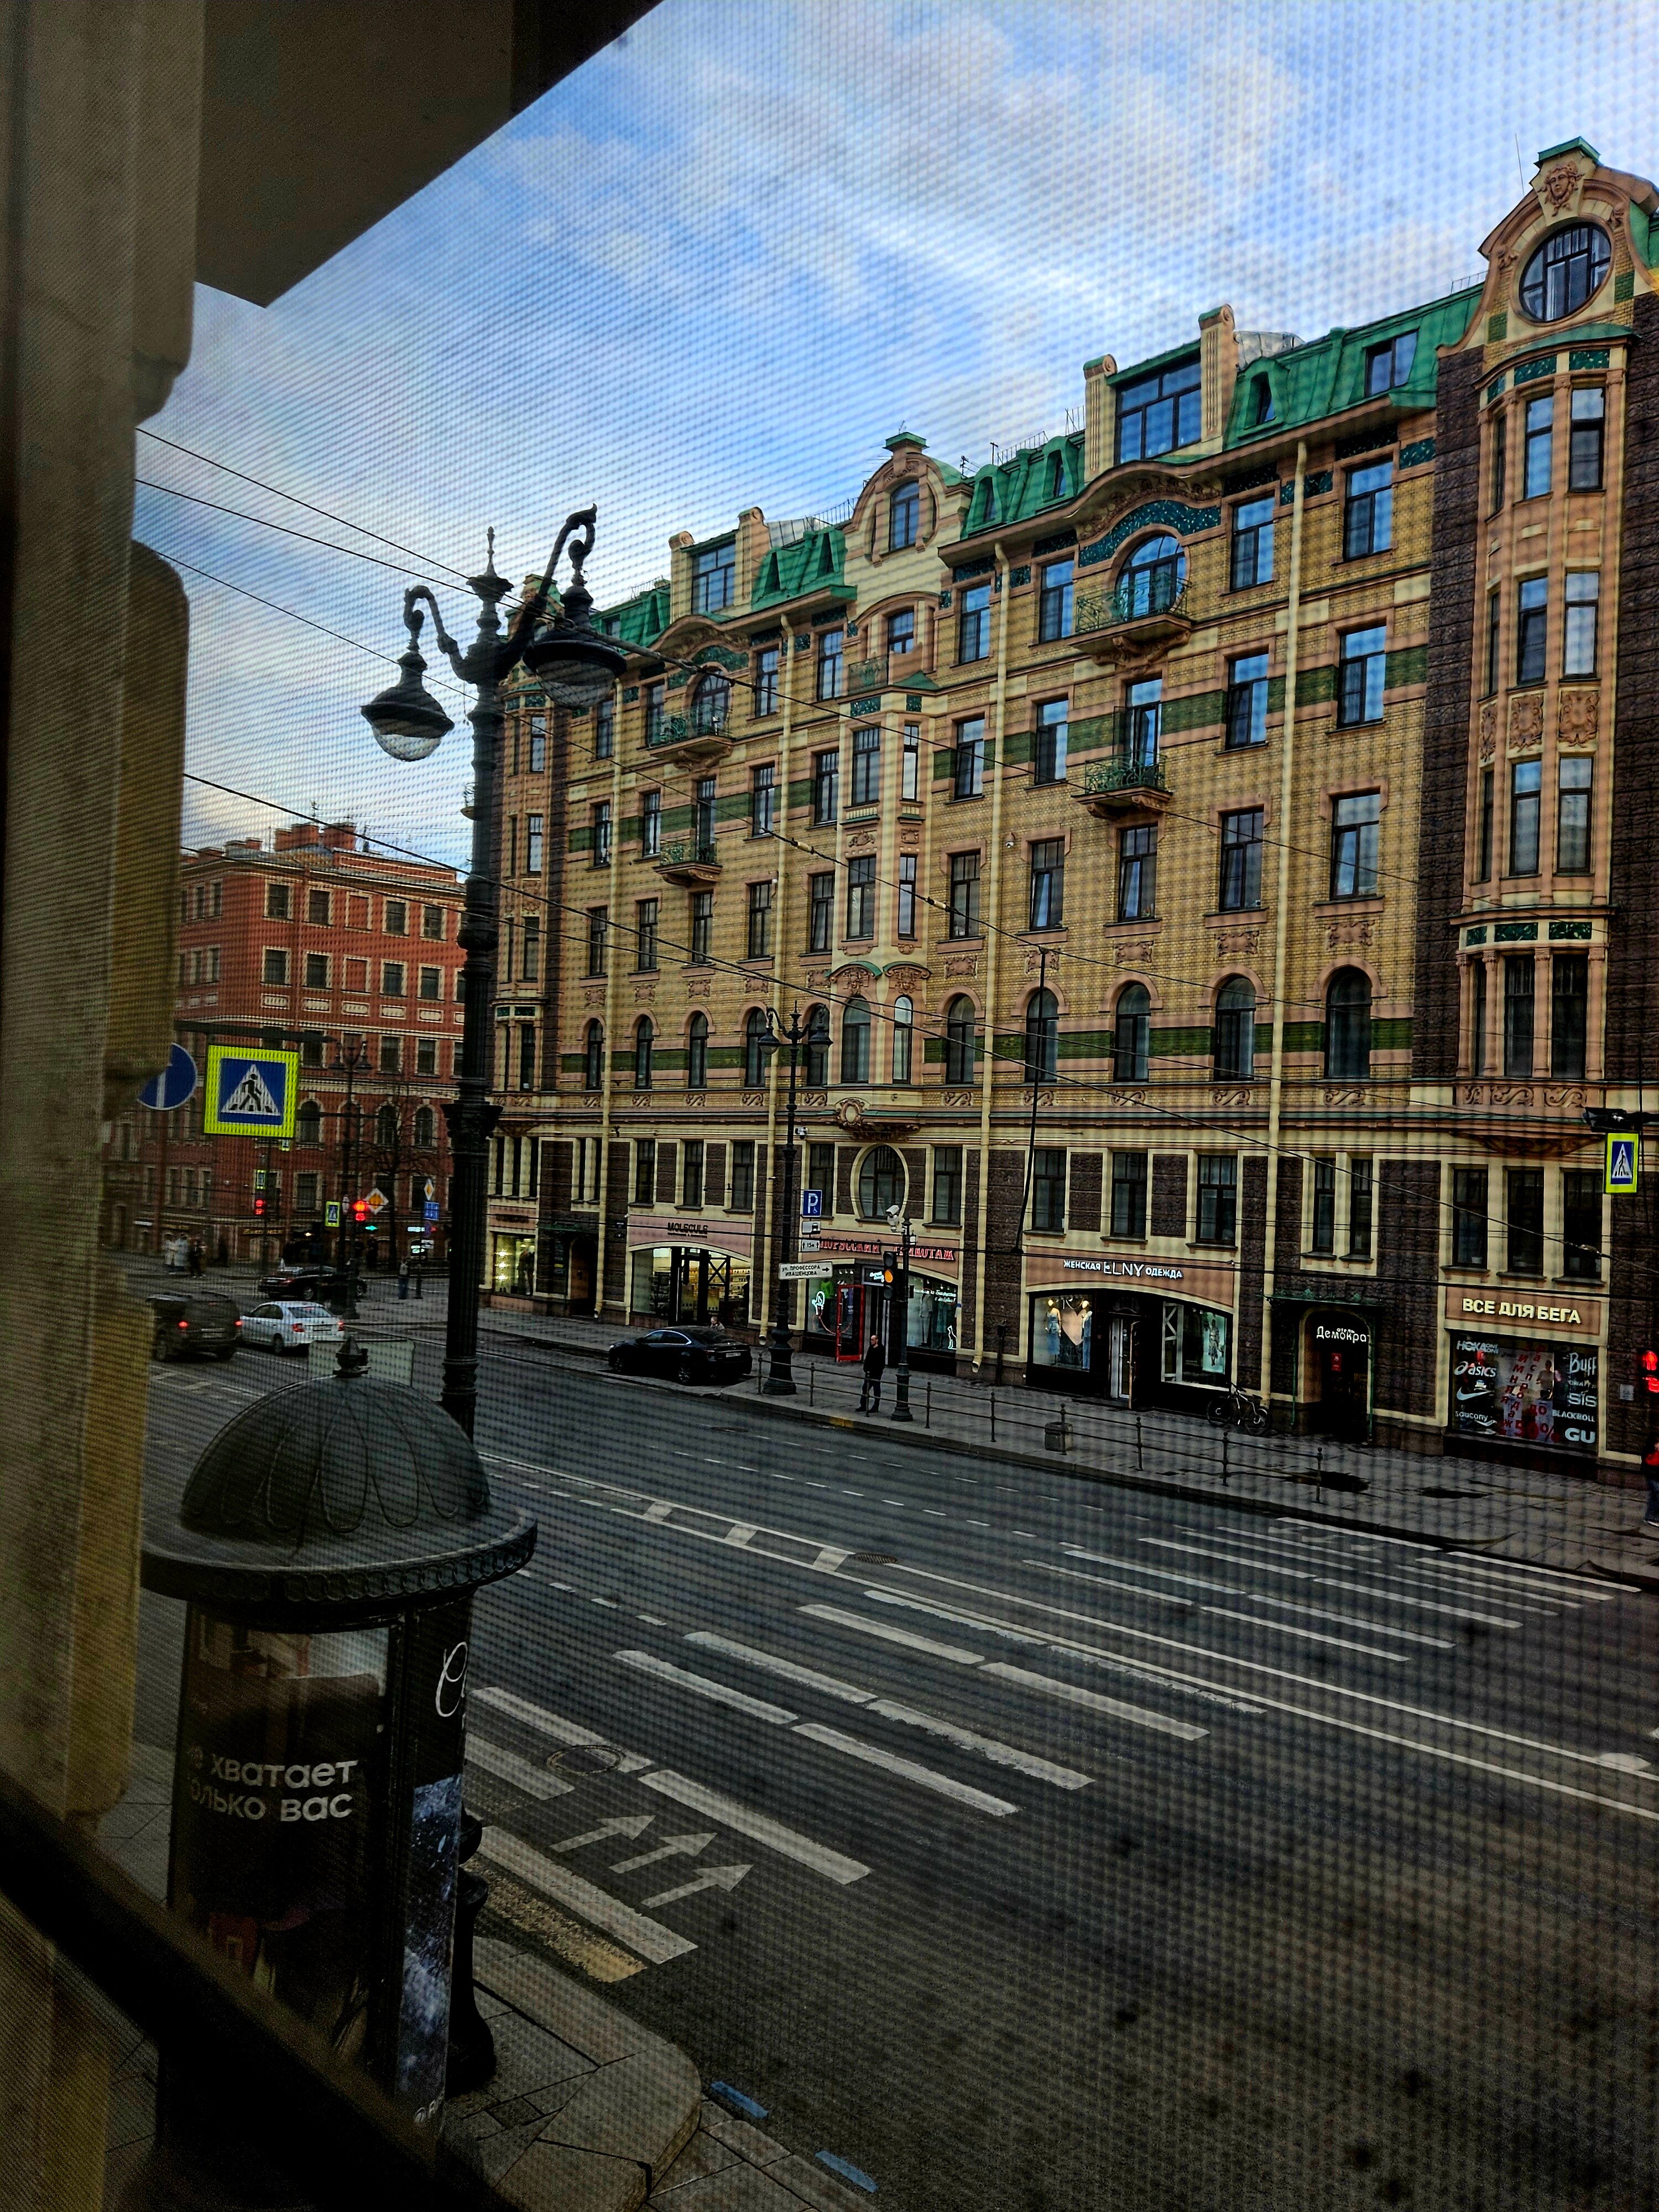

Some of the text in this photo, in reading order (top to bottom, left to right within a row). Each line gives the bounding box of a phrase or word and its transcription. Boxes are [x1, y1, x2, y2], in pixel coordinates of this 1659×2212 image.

[667, 1222, 708, 1234] MOLECULE
[1063, 1260, 1183, 1279] ЖЕНСКАЯ ELNY ОДЕЖДА
[1463, 1298, 1582, 1324] ВСЕ ДЛЯ БЕГА
[1456, 1340, 1486, 1353] HOKA
[1455, 1411, 1489, 1422] saucony
[1564, 1427, 1596, 1443] GU
[211, 1754, 359, 1789] хватает
[190, 1778, 353, 1822] олько вас
